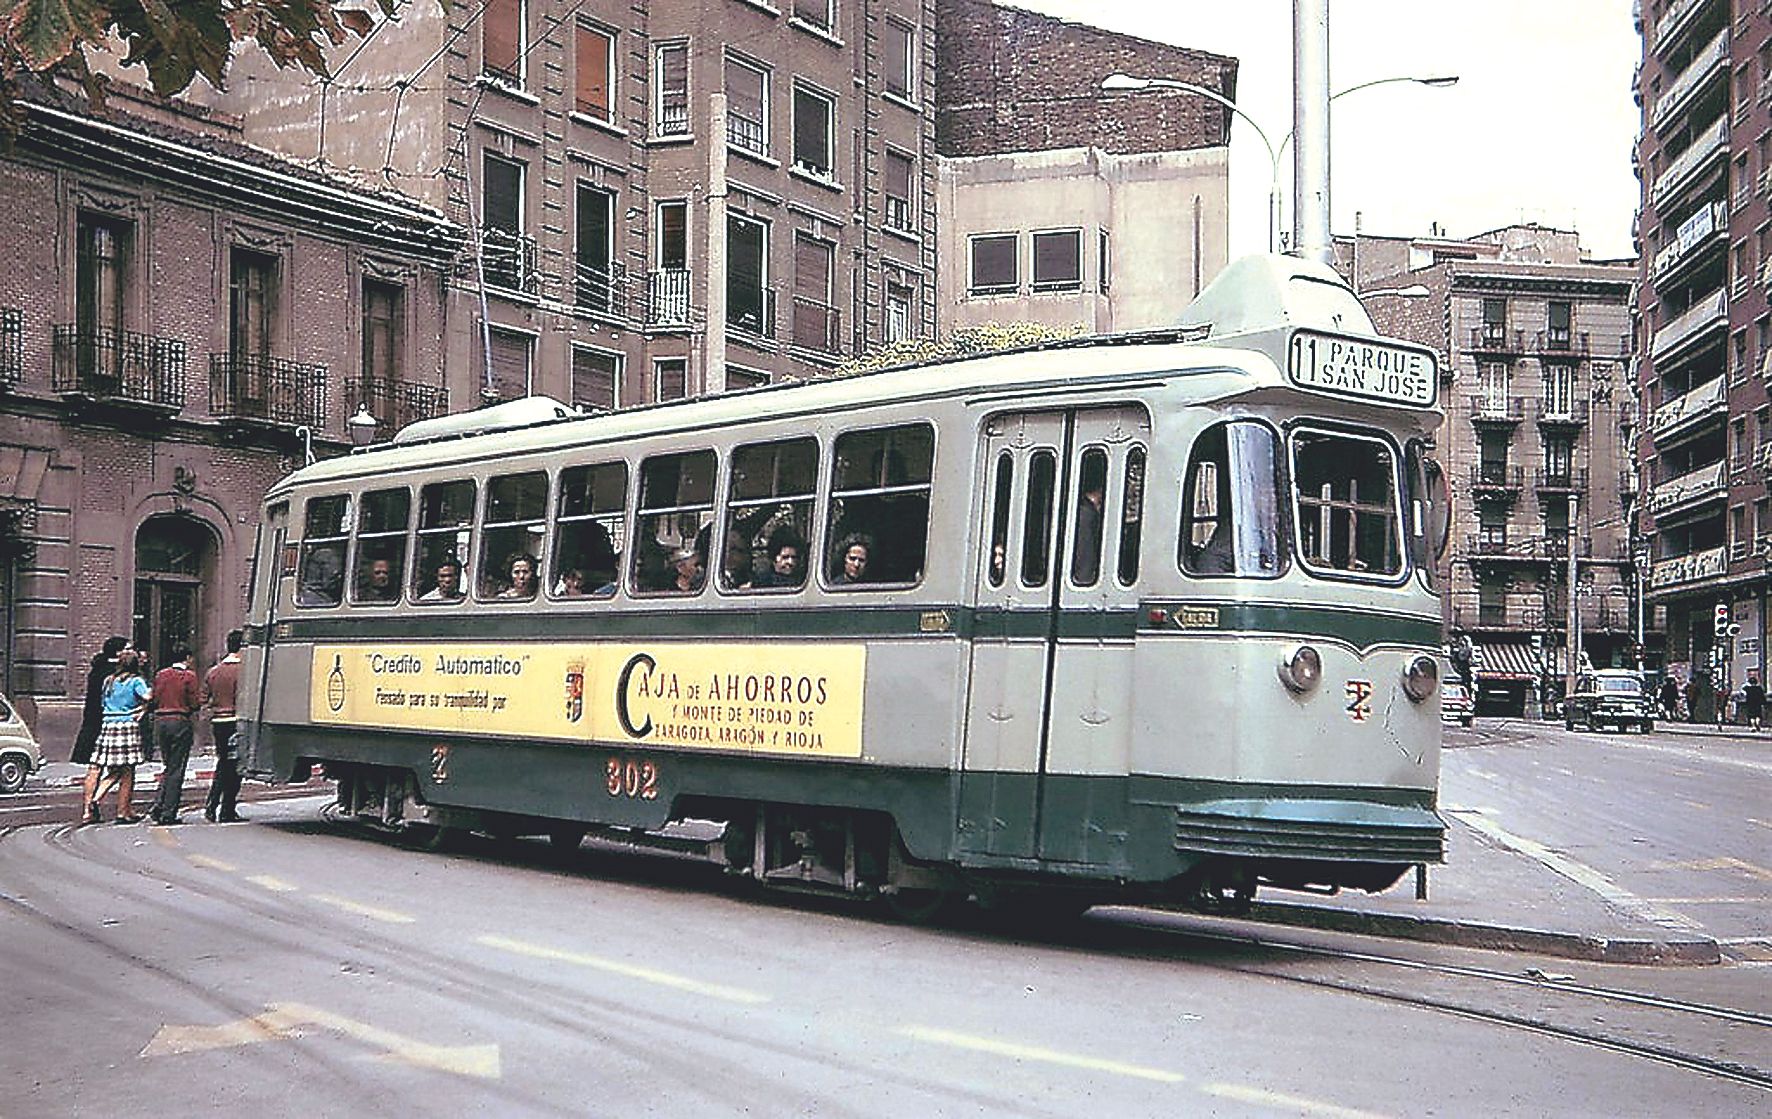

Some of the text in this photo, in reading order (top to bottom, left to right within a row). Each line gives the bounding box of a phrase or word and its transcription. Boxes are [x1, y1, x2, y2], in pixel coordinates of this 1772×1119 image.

[1293, 337, 1315, 382] 11
[1330, 342, 1421, 377] PARQUE
[1322, 363, 1427, 400] SAN JOSE
[687, 685, 700, 700] DE
[709, 674, 827, 705] AHORROS
[672, 705, 814, 727] Y MONTE DE PIEDAD DE
[773, 732, 778, 745] Y
[785, 732, 823, 749] RIOJA
[608, 758, 657, 799] 302
